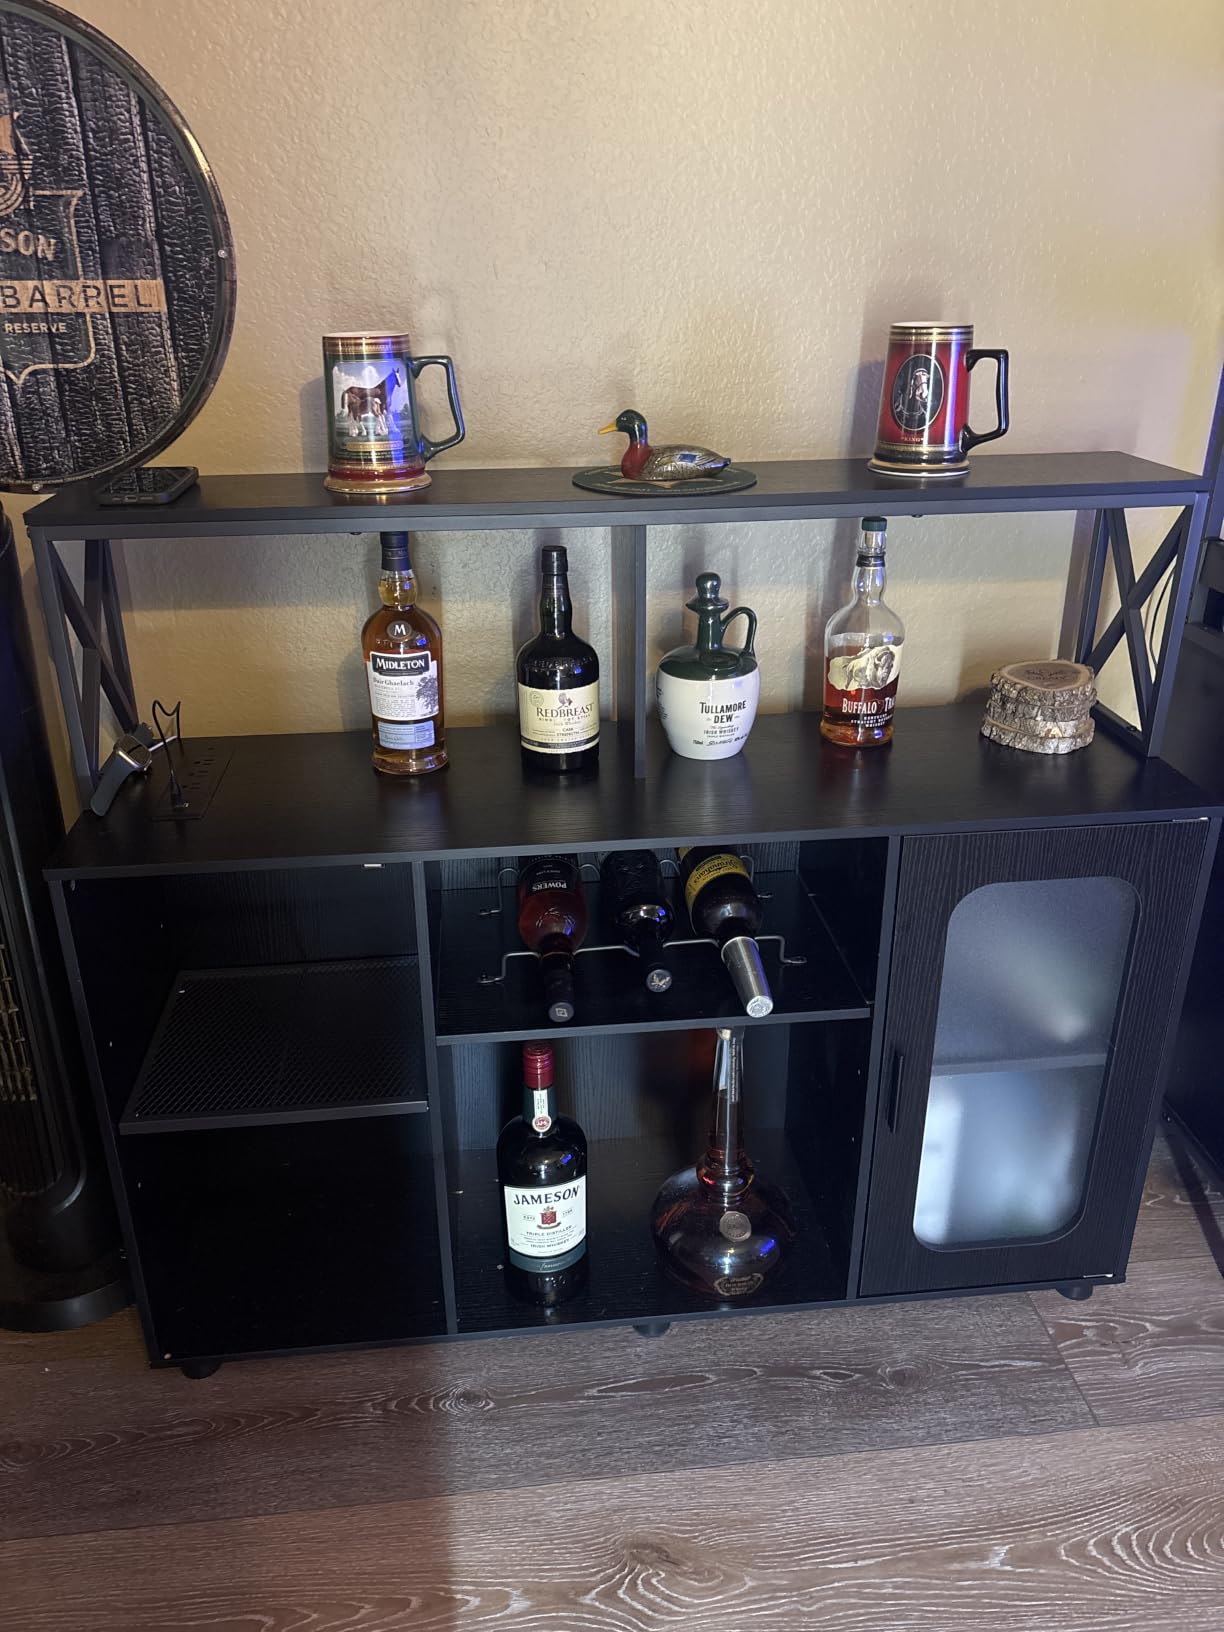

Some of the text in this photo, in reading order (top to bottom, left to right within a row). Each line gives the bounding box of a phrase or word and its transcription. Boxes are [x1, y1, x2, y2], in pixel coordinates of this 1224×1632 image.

[0, 284, 152, 309] BARREL
[4, 323, 67, 333] RESERVE
[394, 624, 406, 636] M
[376, 658, 425, 670] MIDLETON
[536, 702, 594, 718] REDBREAST
[699, 700, 747, 714] TULLAMORE
[842, 697, 877, 714] BUFFALO
[713, 714, 733, 724] DEW
[531, 881, 568, 892] POWERS
[513, 1186, 579, 1206] JAMESON
